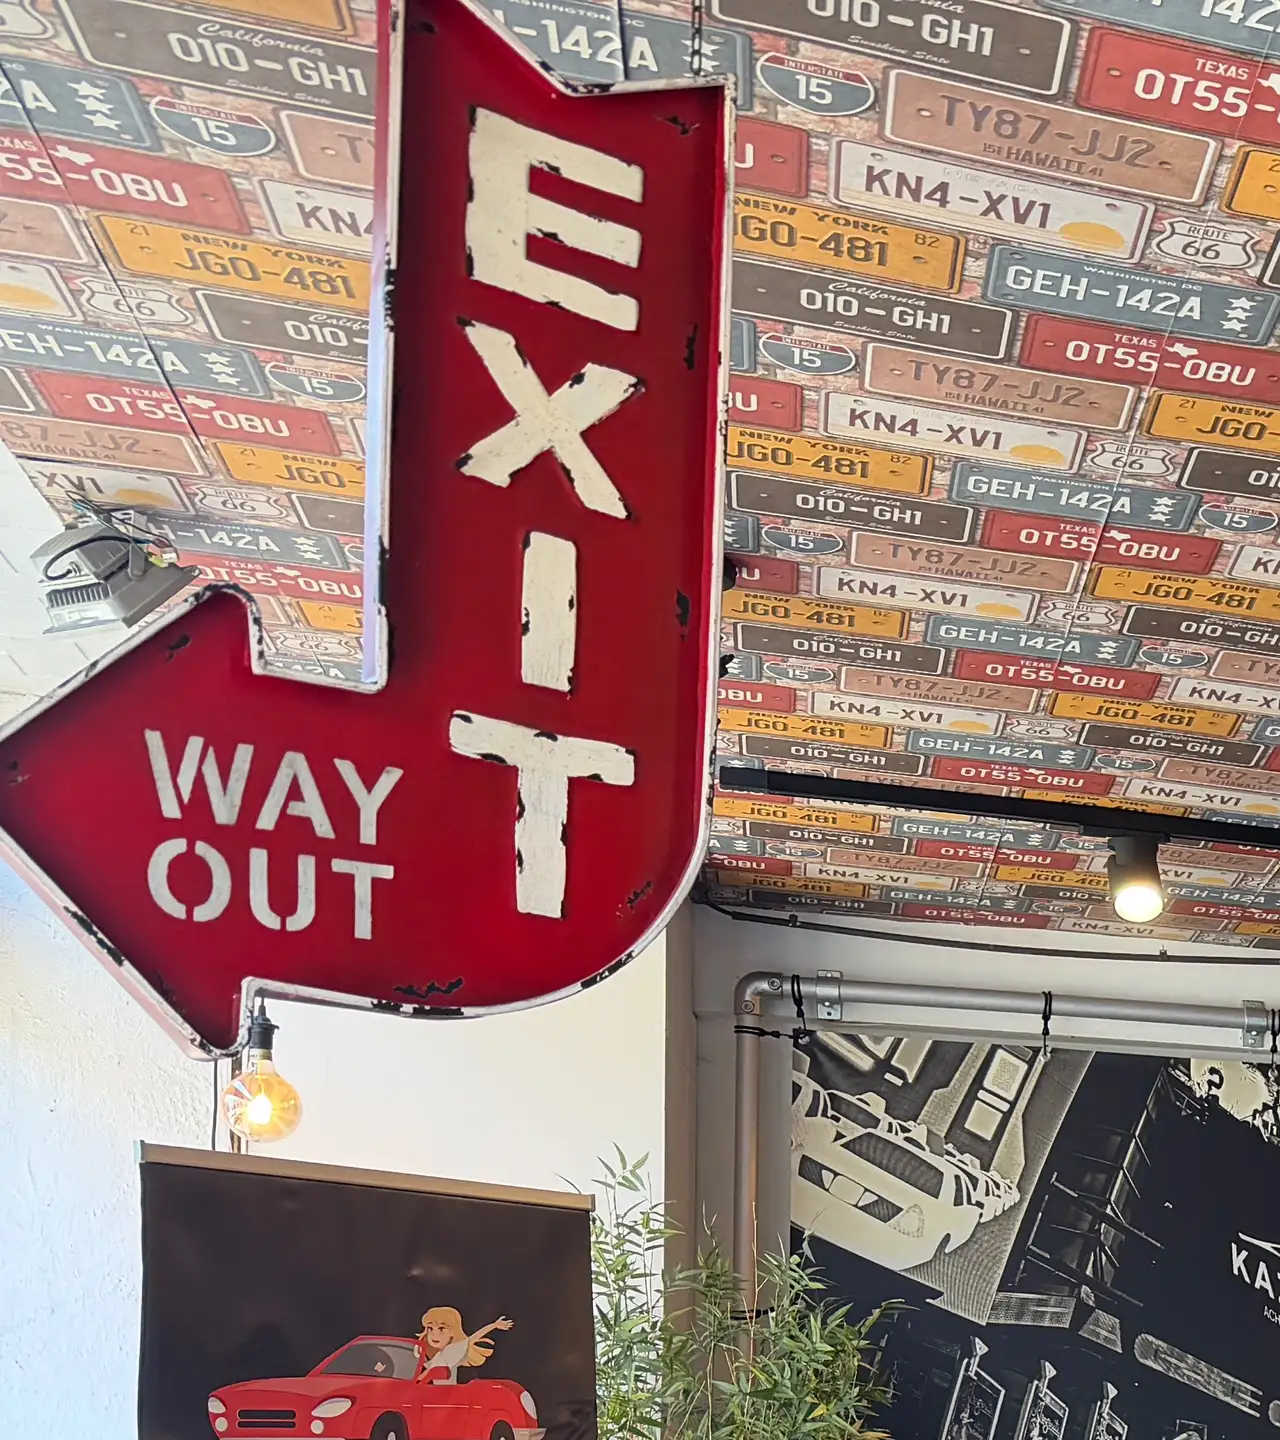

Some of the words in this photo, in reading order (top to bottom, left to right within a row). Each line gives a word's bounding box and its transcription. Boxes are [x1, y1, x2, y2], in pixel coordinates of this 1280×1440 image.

[198, 24, 326, 55] California
[1197, 59, 1247, 79] TEXAS
[796, 76, 832, 103] 15
[192, 119, 236, 144] 15
[1184, 226, 1231, 242] ROUTE
[1182, 240, 1220, 259] 66
[1006, 267, 1200, 320] GEH-142A
[1115, 333, 1157, 347] TEXAS
[447, 105, 645, 918] EXIT
[143, 728, 404, 846] WAY
[146, 836, 394, 940] OUT
